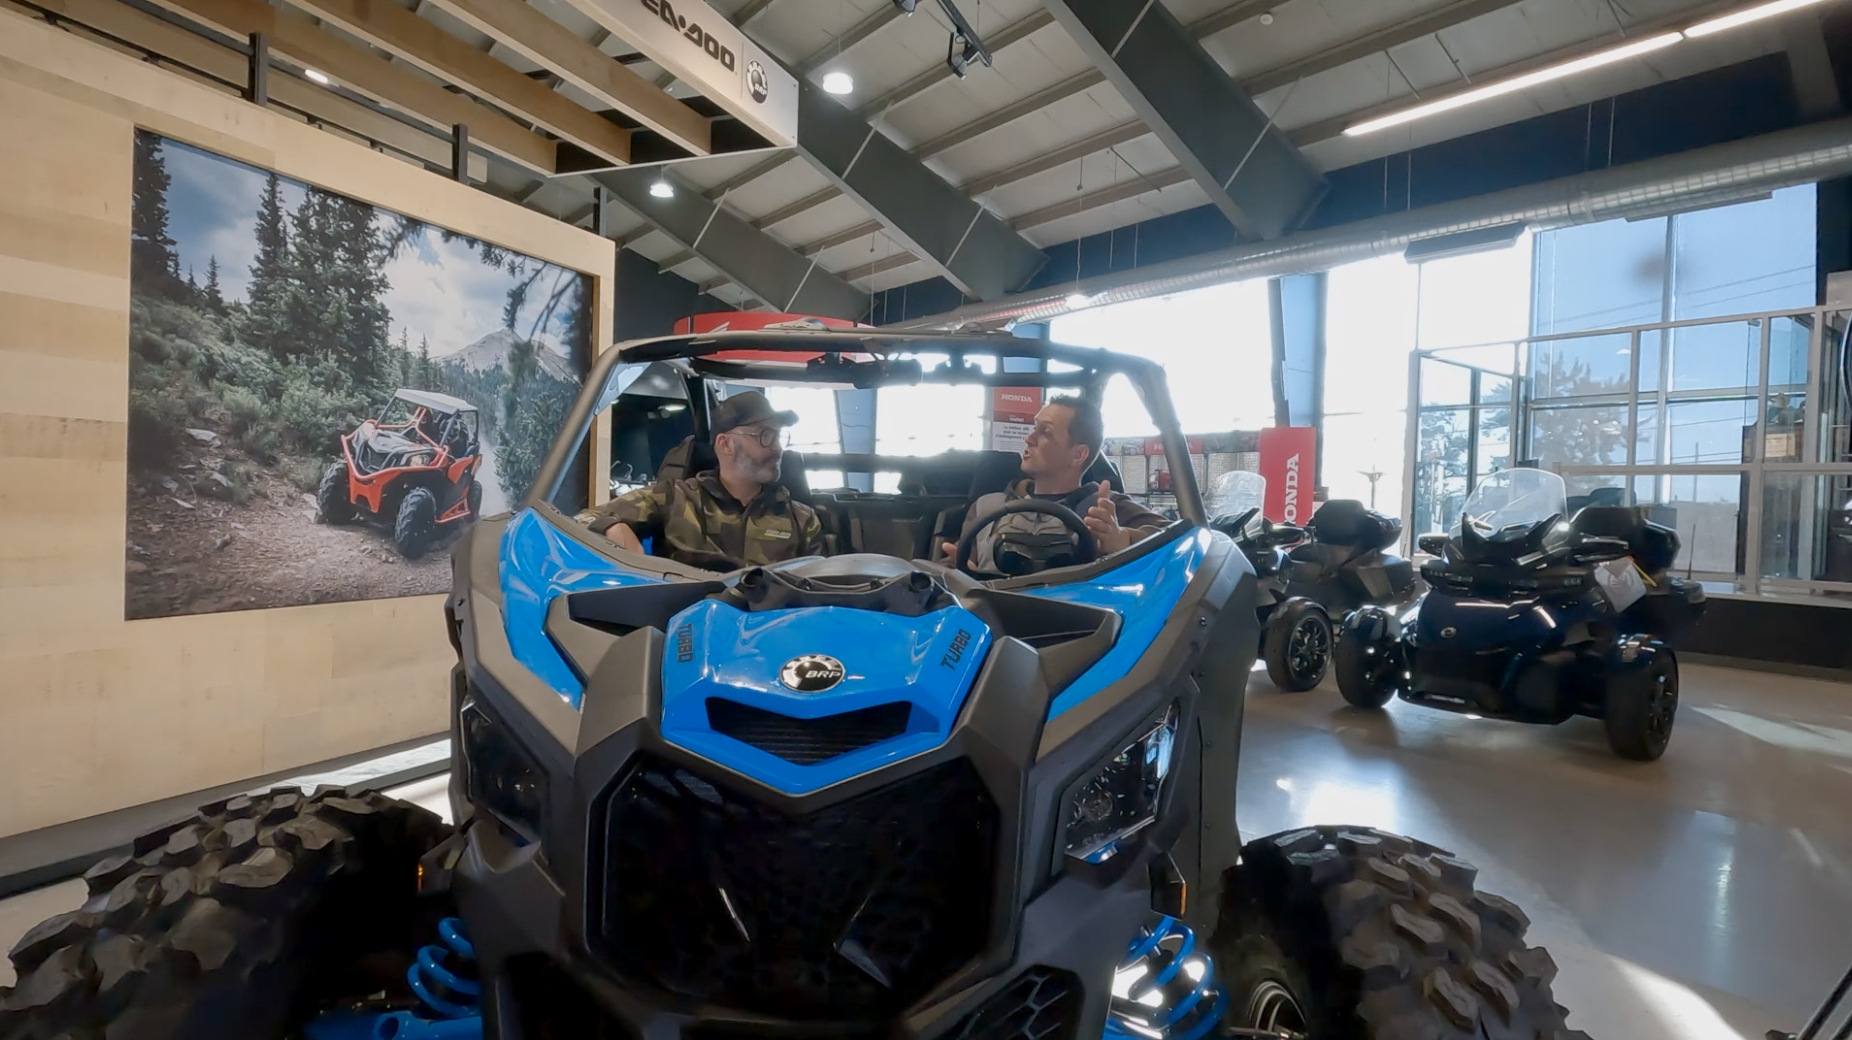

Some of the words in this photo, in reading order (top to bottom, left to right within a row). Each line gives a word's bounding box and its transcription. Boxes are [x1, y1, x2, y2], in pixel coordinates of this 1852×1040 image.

[1001, 393, 1033, 403] HONDA
[1284, 453, 1299, 524] ONDA
[678, 623, 693, 663] TURBO
[941, 629, 971, 670] TURBO
[805, 670, 841, 679] BRP
